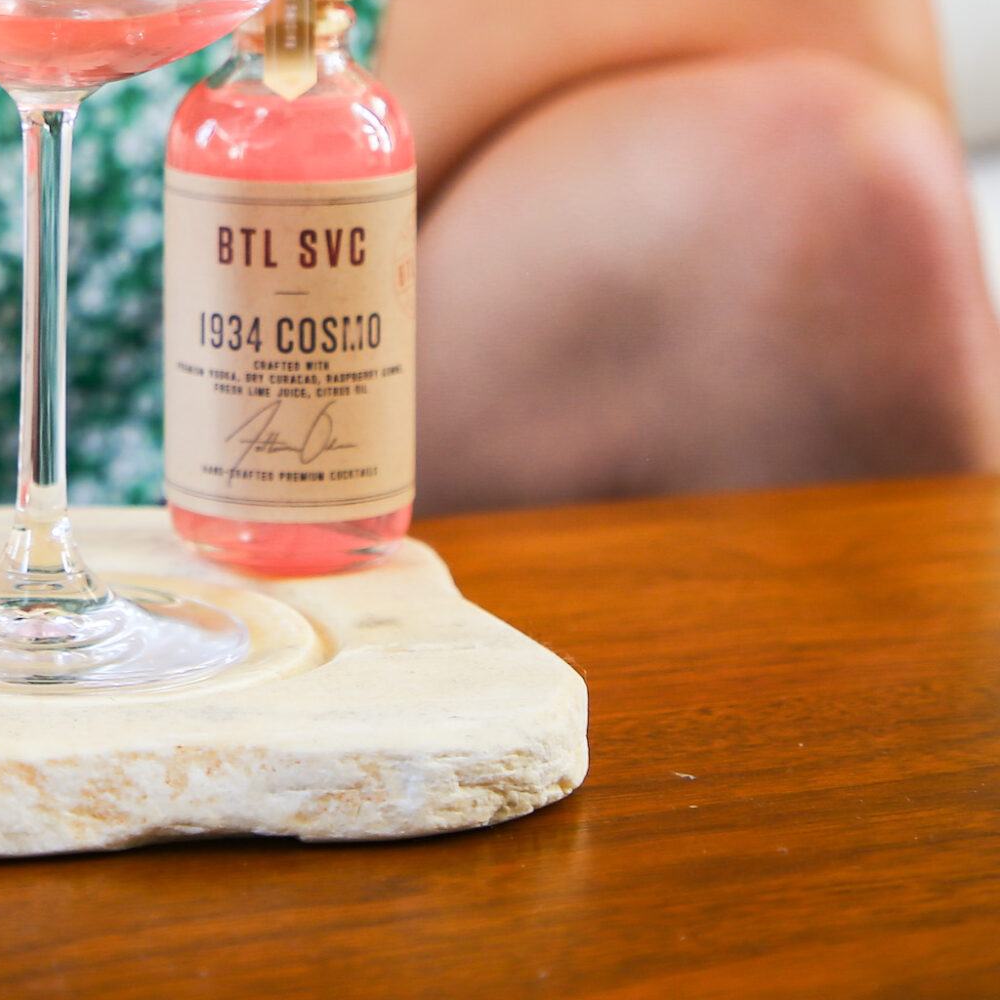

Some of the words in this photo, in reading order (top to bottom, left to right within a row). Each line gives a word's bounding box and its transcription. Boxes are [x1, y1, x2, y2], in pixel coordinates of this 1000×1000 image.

[217, 225, 279, 269] BTL
[298, 226, 366, 270] SVC
[200, 311, 263, 353] 1934
[276, 312, 382, 355] COSMO
[253, 359, 301, 372] CRAFTED
[305, 359, 330, 371] WITH
[245, 373, 268, 385] DRY
[213, 382, 244, 396] FRESH
[247, 385, 272, 398] LIME
[276, 386, 312, 400] JUICE,
[315, 384, 352, 398] CITRUS
[278, 471, 326, 482] PREMIUM
